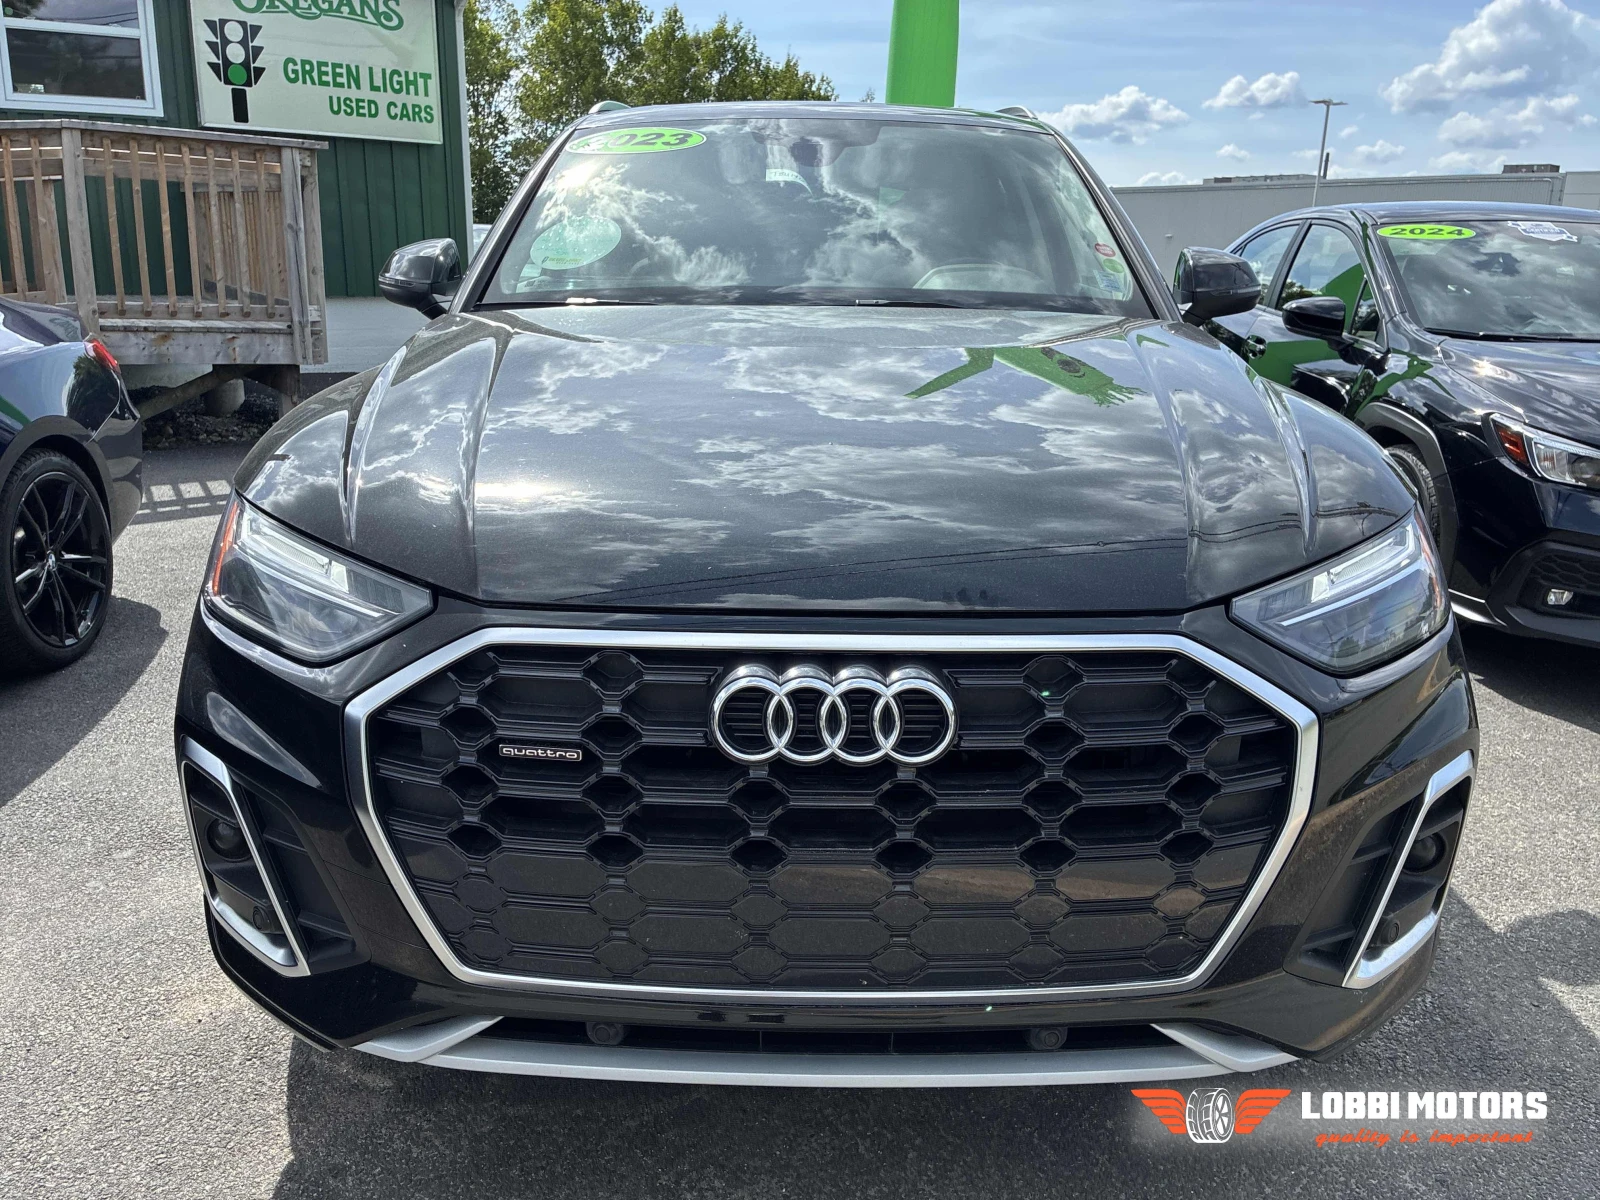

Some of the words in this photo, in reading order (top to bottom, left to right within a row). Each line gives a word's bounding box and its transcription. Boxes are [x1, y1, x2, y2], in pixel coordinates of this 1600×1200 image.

[283, 57, 361, 90] GREEN
[368, 66, 432, 97] LIGHT
[329, 95, 379, 118] USED
[386, 101, 434, 124] CARS
[1389, 227, 1465, 236] 2024
[502, 747, 578, 759] quattro
